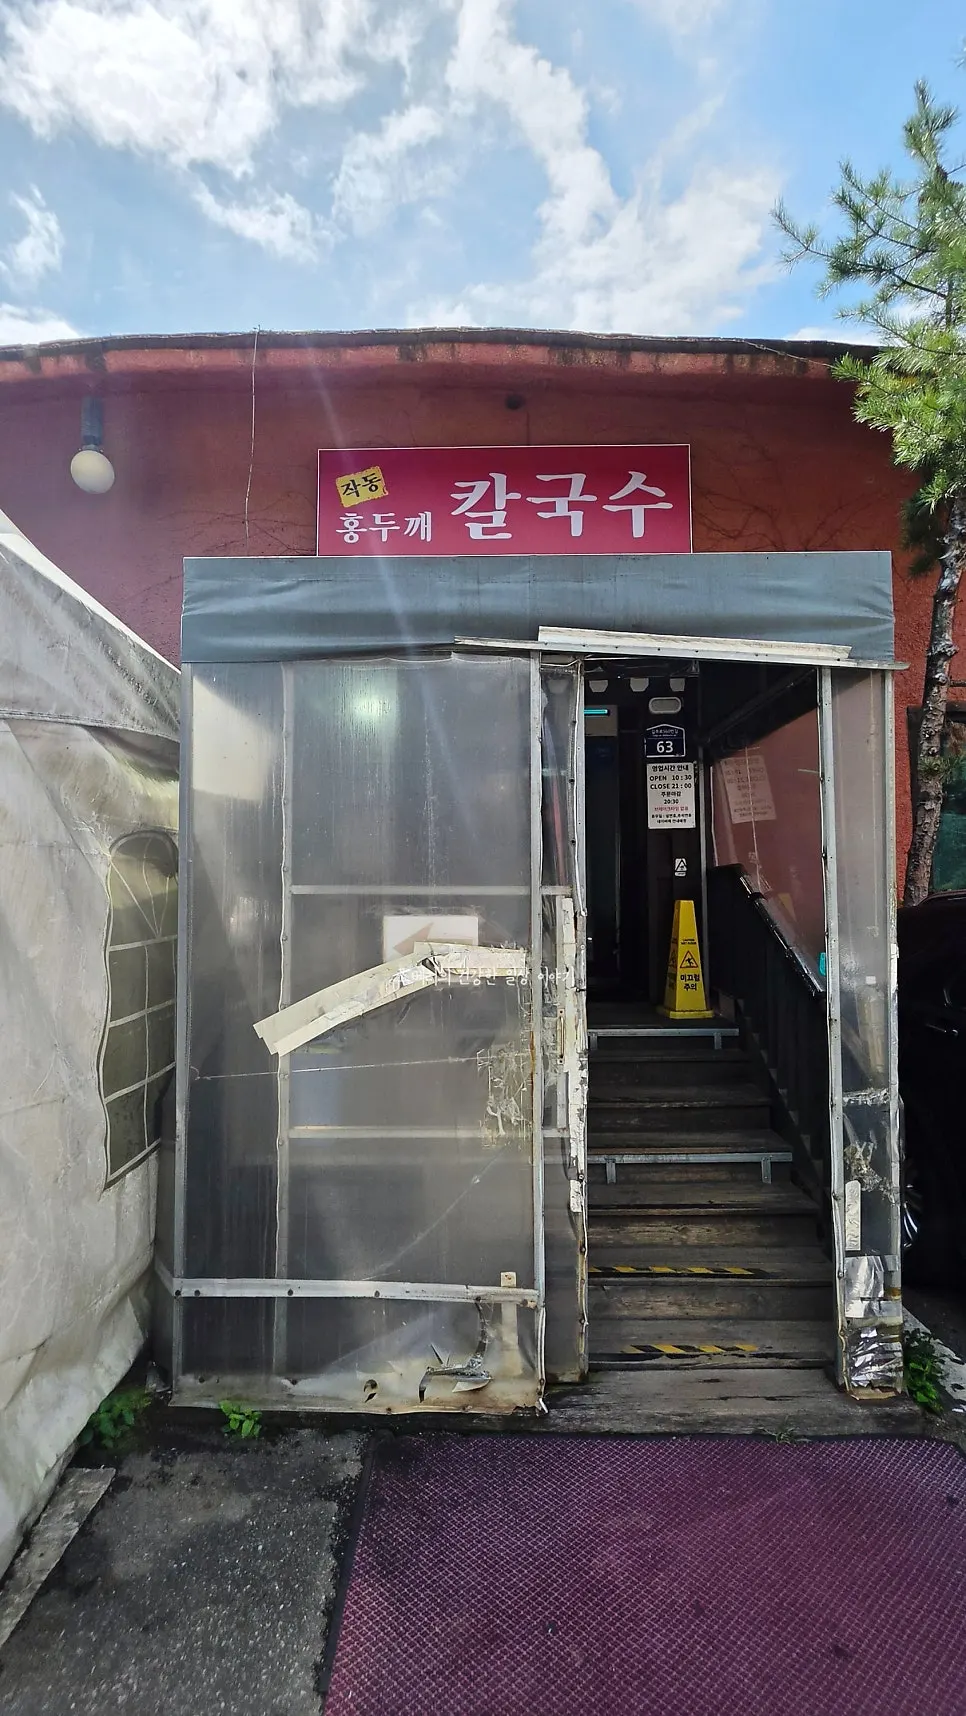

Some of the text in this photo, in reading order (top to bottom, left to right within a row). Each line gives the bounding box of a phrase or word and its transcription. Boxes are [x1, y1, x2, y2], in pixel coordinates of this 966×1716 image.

[341, 472, 383, 498] 작동
[335, 471, 675, 543] 홍두깨 칼국수
[656, 740, 674, 753] 63
[651, 764, 689, 772] 영업시간 안내
[680, 973, 700, 982] 미끄럼
[683, 983, 697, 991] 주의
